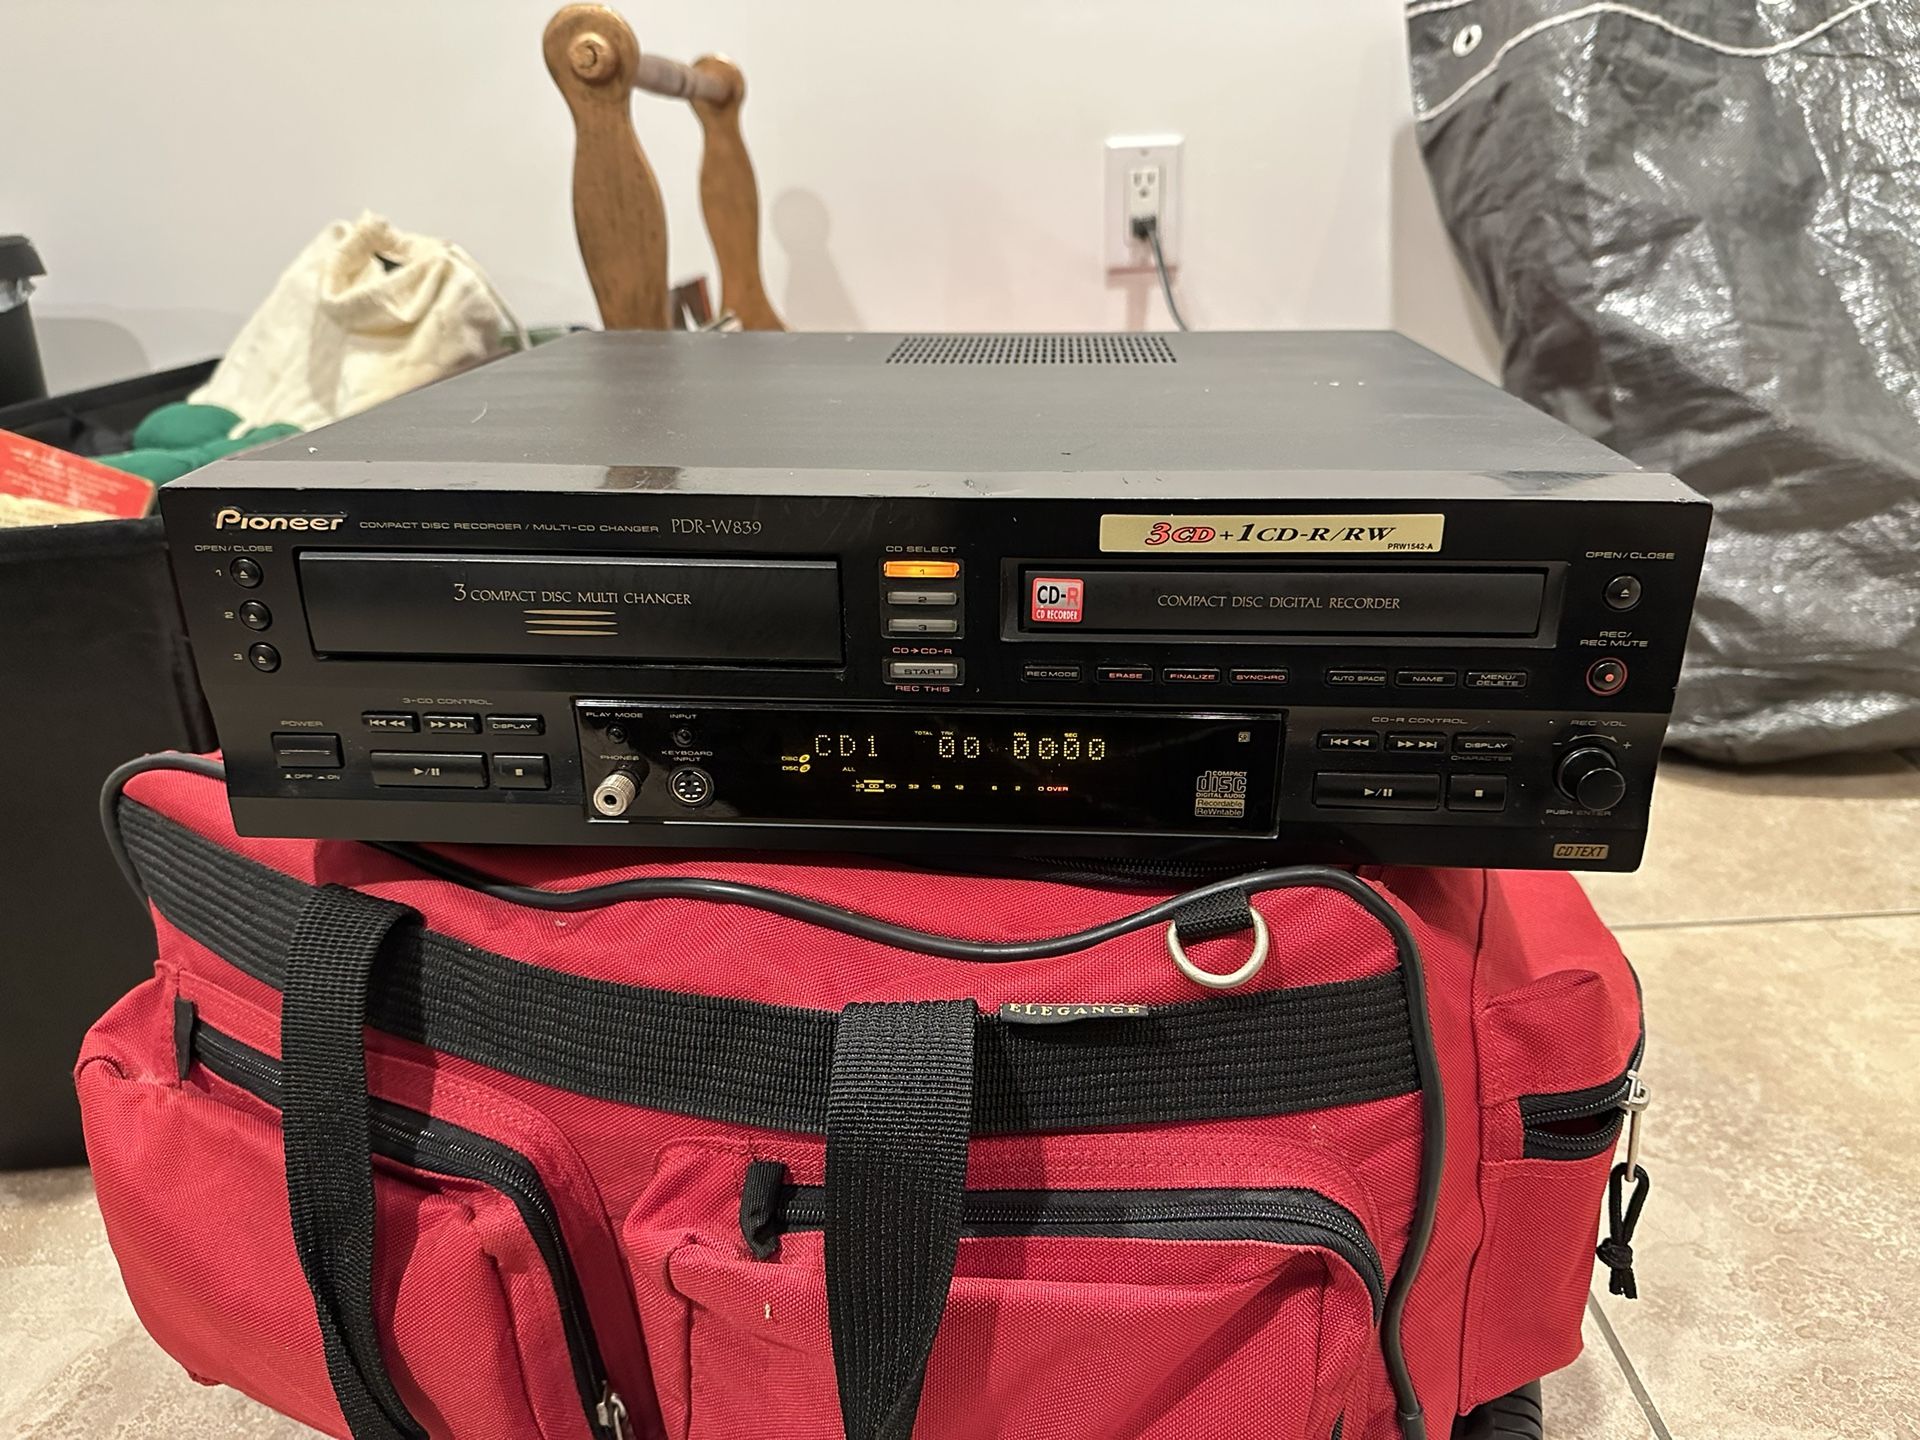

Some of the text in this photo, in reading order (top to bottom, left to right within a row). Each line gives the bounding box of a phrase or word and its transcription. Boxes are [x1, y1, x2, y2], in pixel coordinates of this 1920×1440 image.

[215, 508, 345, 531] Pioneer
[359, 521, 417, 529] COMPACT
[421, 522, 450, 530] DISC
[453, 522, 522, 530] RECORDER
[532, 524, 596, 532] MULTI-CD
[599, 525, 660, 533] CHANGER
[671, 518, 762, 535] PDR-W839
[194, 544, 274, 553] OPEN/CLOSE
[885, 545, 957, 553] CD SELECT
[1387, 542, 1434, 550] PRW1542-A
[1585, 551, 1676, 560] OPEN/CLOSE
[453, 583, 693, 606] 3 COMPACT DISC MULTI CHANGER
[917, 595, 928, 603] 2
[1036, 585, 1080, 605] CD-R
[1157, 594, 1401, 610] COMPACT DISC DIGITAL RECORDER
[224, 611, 235, 619] 2
[1036, 609, 1079, 620] CD RECORDER
[233, 653, 243, 661] 3
[903, 668, 944, 676] START
[1108, 672, 1144, 680] ERASE
[1169, 673, 1216, 681] FINALIZE
[402, 697, 493, 706] 3-CD CONTROL
[1371, 716, 1469, 725] CD-R CONTROL
[1570, 719, 1597, 727] REC
[1196, 770, 1247, 793] disc
[1197, 799, 1242, 807] Recordable
[1196, 807, 1242, 816] ReWritable
[1545, 808, 1573, 816] PUSH
[1556, 846, 1605, 858] CD TEXT
[1009, 1003, 1140, 1016] ELEGANCE
